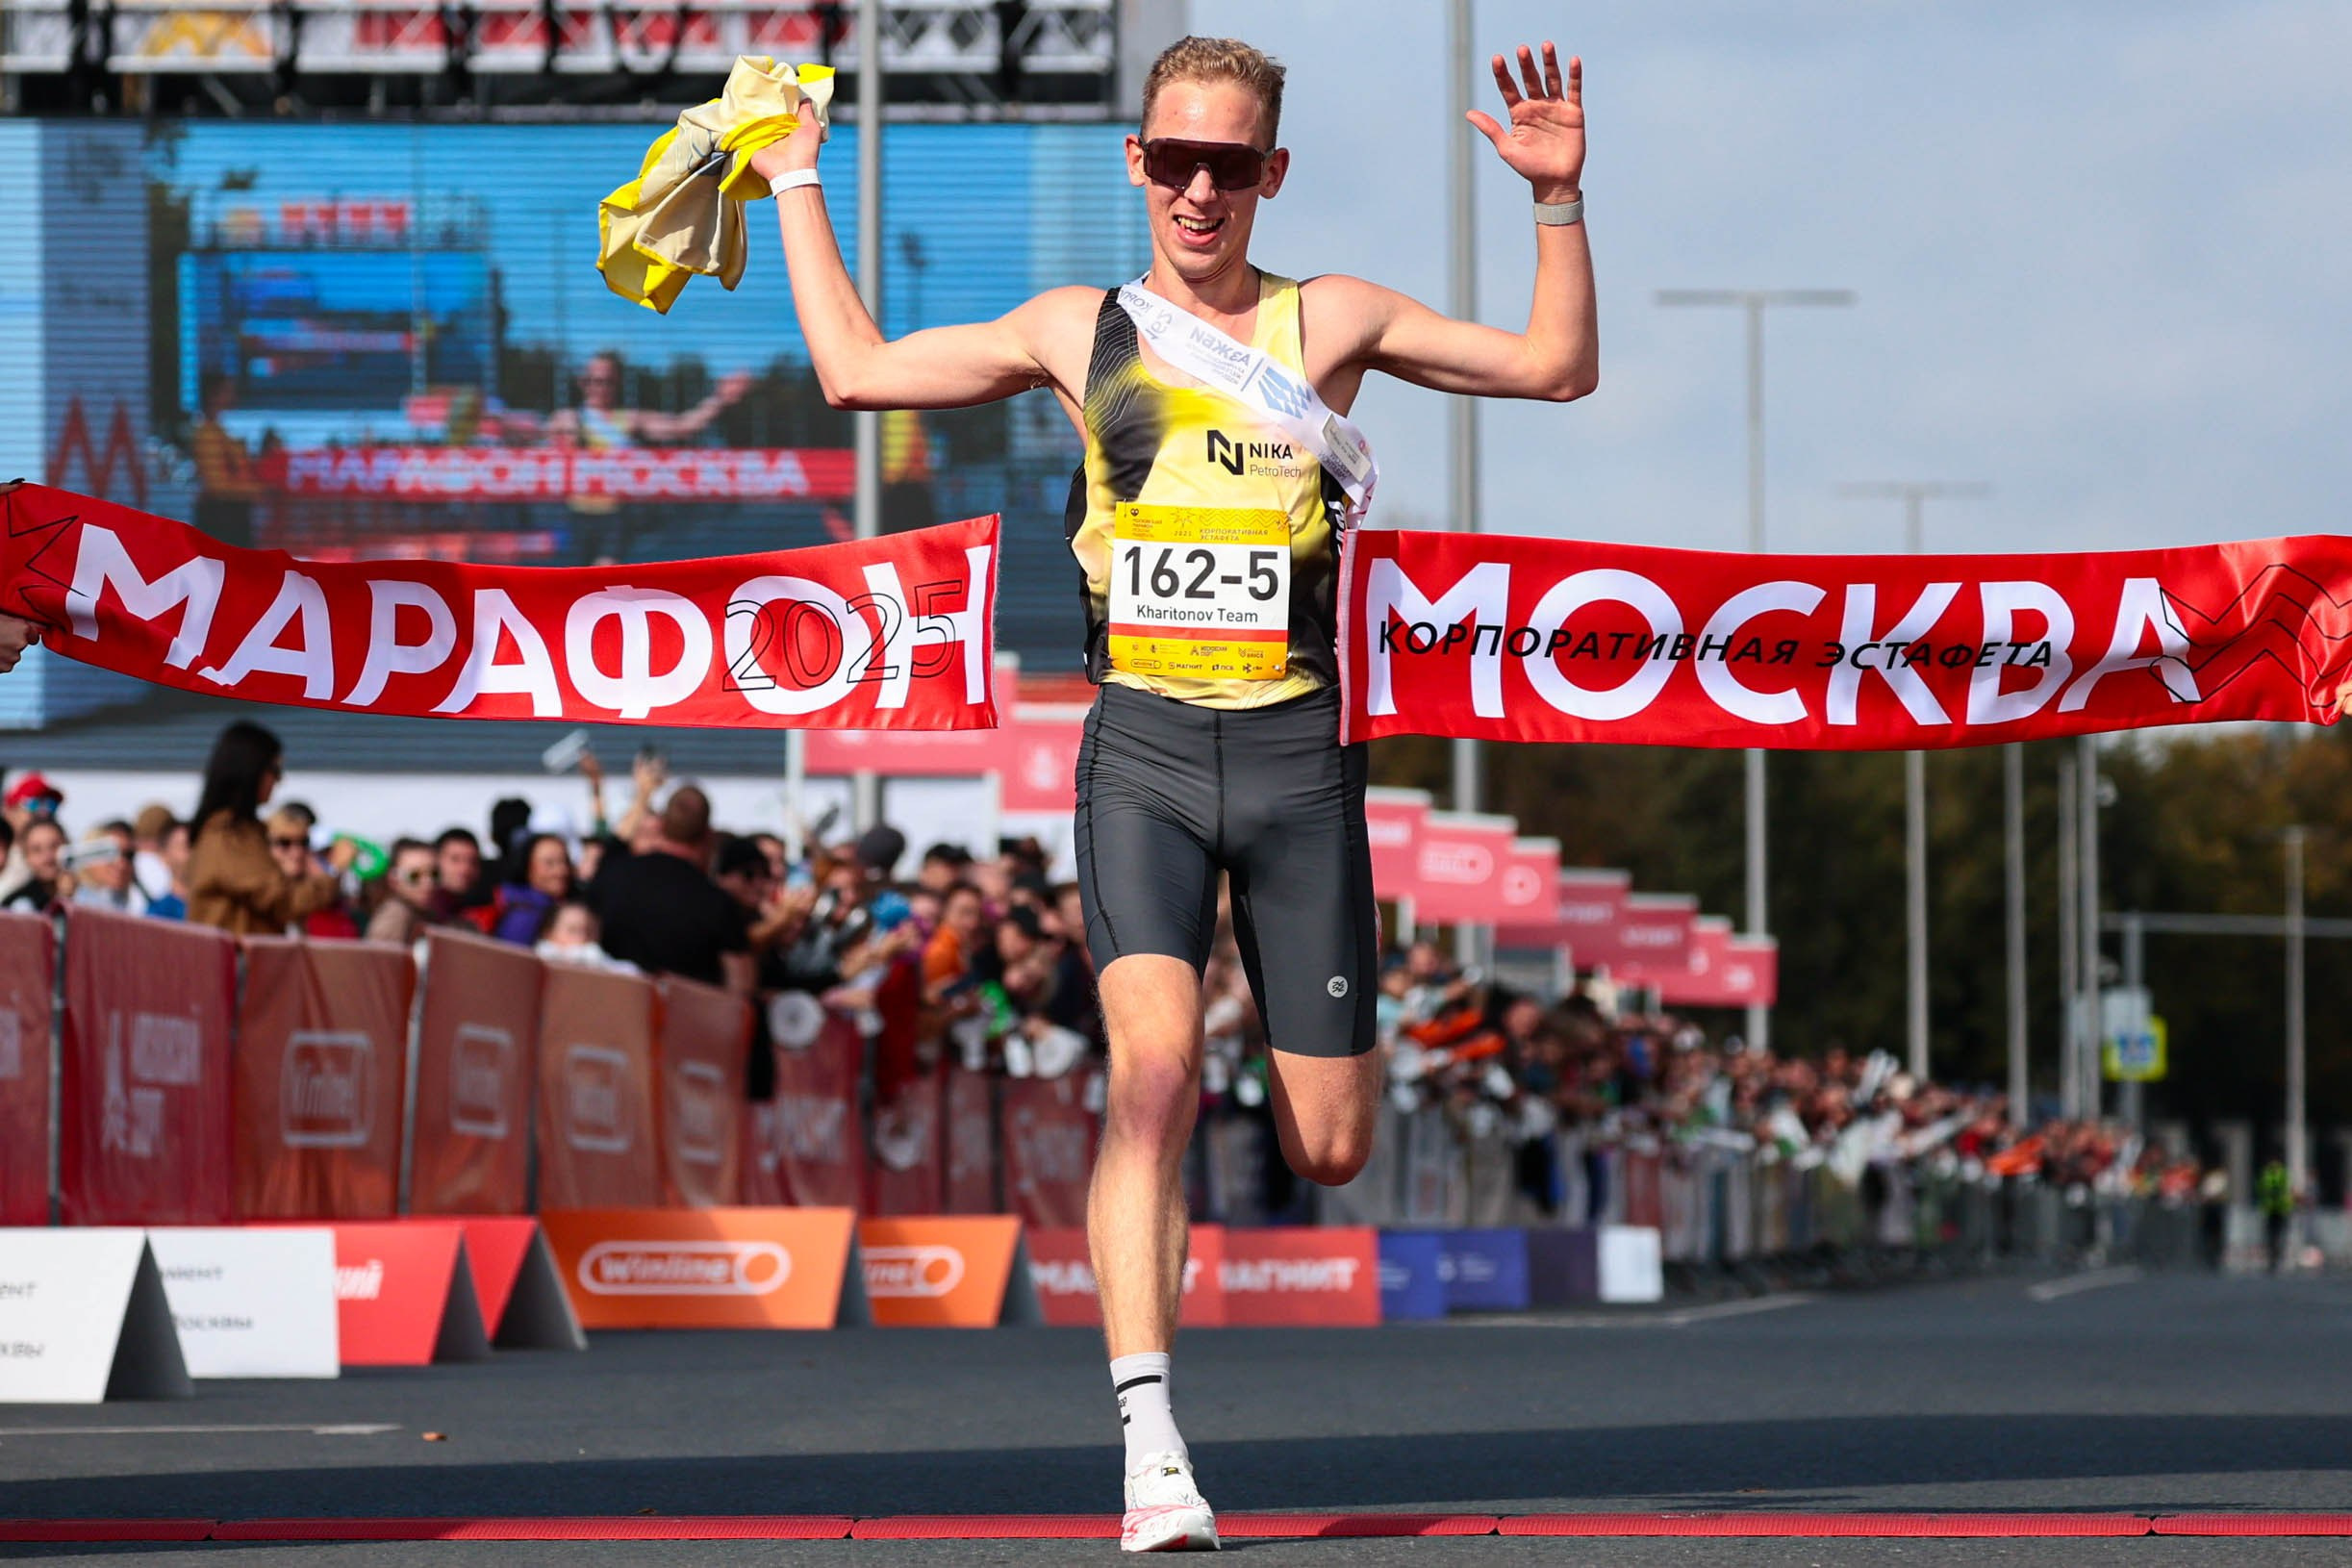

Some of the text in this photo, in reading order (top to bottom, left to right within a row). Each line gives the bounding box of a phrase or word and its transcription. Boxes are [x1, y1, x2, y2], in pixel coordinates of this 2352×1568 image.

[1250, 443, 1293, 460] NIKA
[1250, 464, 1302, 478] PetroTech
[1125, 545, 1279, 601] 162-5
[65, 523, 992, 720] МАРАФОН
[722, 579, 962, 693] 2025
[1136, 604, 1258, 623] Kharitonov Team
[1366, 557, 2202, 726] МОСКВА
[1378, 620, 2052, 670] КОРПОРАТИВНАЯ ЭСТАФЕТА
